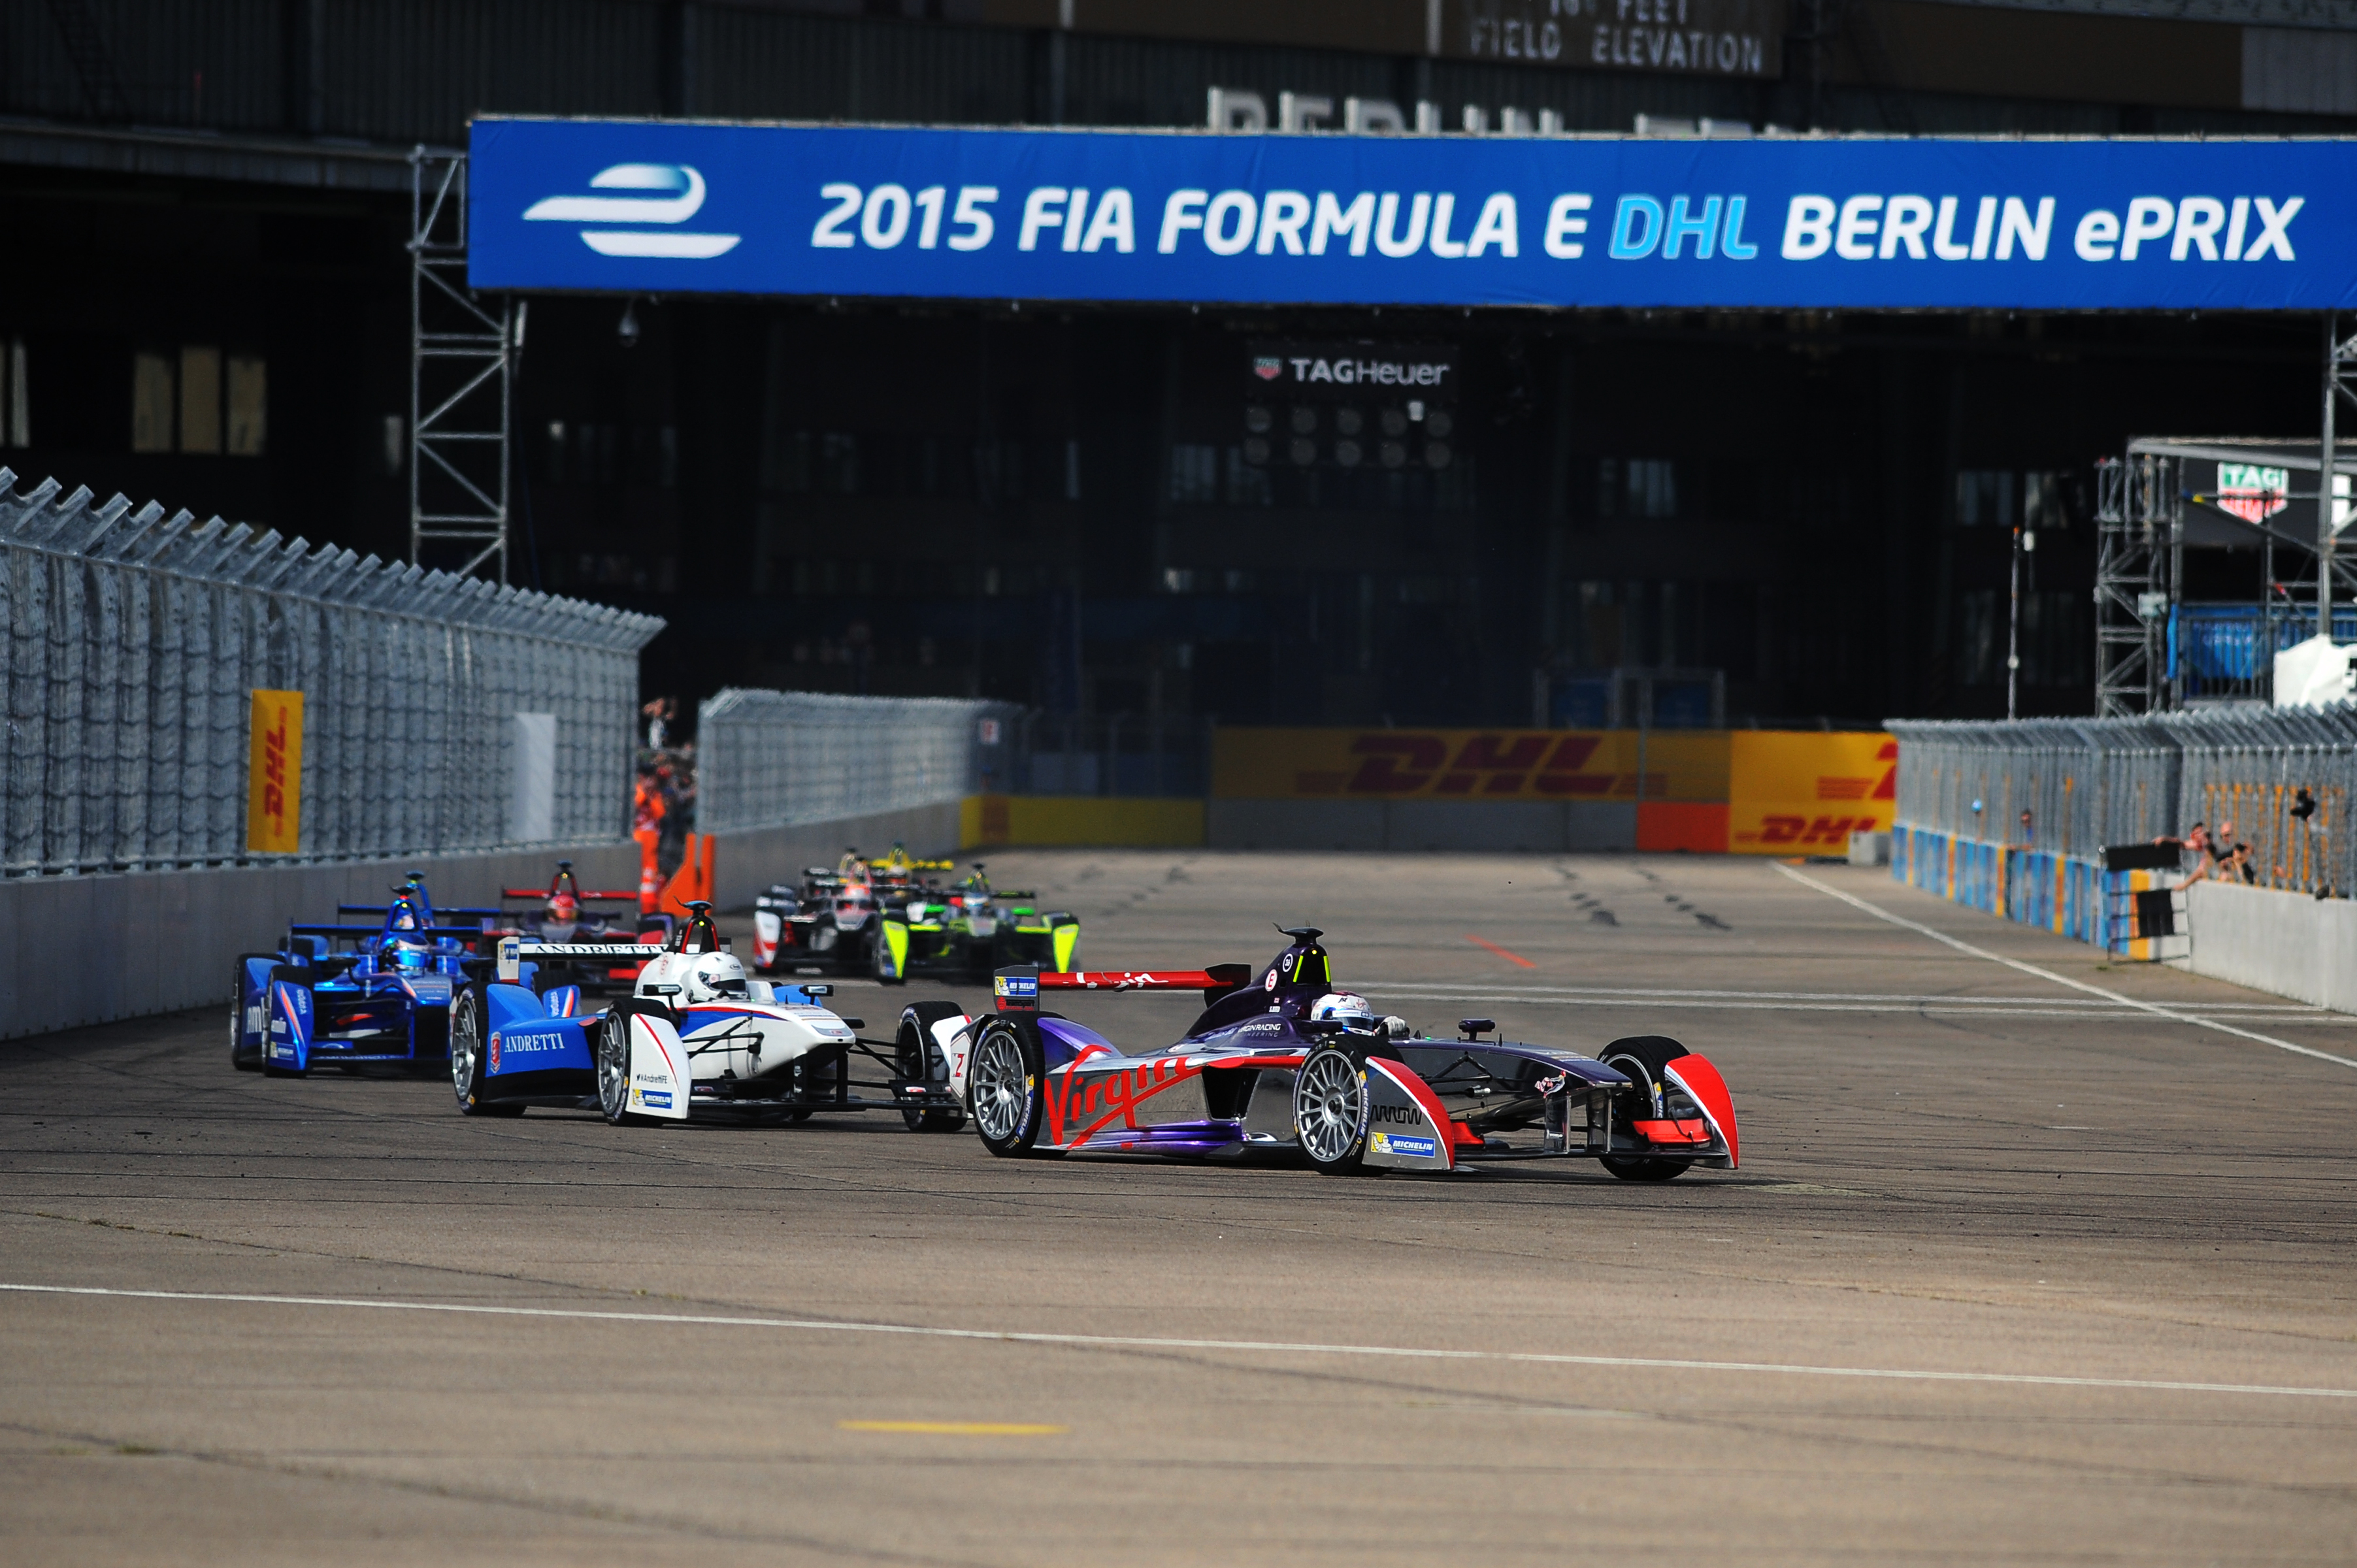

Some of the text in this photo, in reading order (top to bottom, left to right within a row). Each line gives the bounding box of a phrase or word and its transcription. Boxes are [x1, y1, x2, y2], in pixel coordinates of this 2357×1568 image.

[1470, 18, 1763, 73] FIELD ELEVATION
[812, 184, 2305, 262] 2015 FIA FORMULA E DHL BERLIN ePRIX
[2226, 465, 2281, 487] TAG
[264, 725, 286, 817] DHL
[1347, 736, 1614, 794] DHL
[504, 1033, 565, 1053] ANDRETTI
[1018, 1096, 1032, 1137] MICHELIN
[1044, 1044, 1205, 1150] Virgin
[1360, 1088, 1369, 1135] MICHELIN
[1393, 1140, 1434, 1151] MICHELIN
